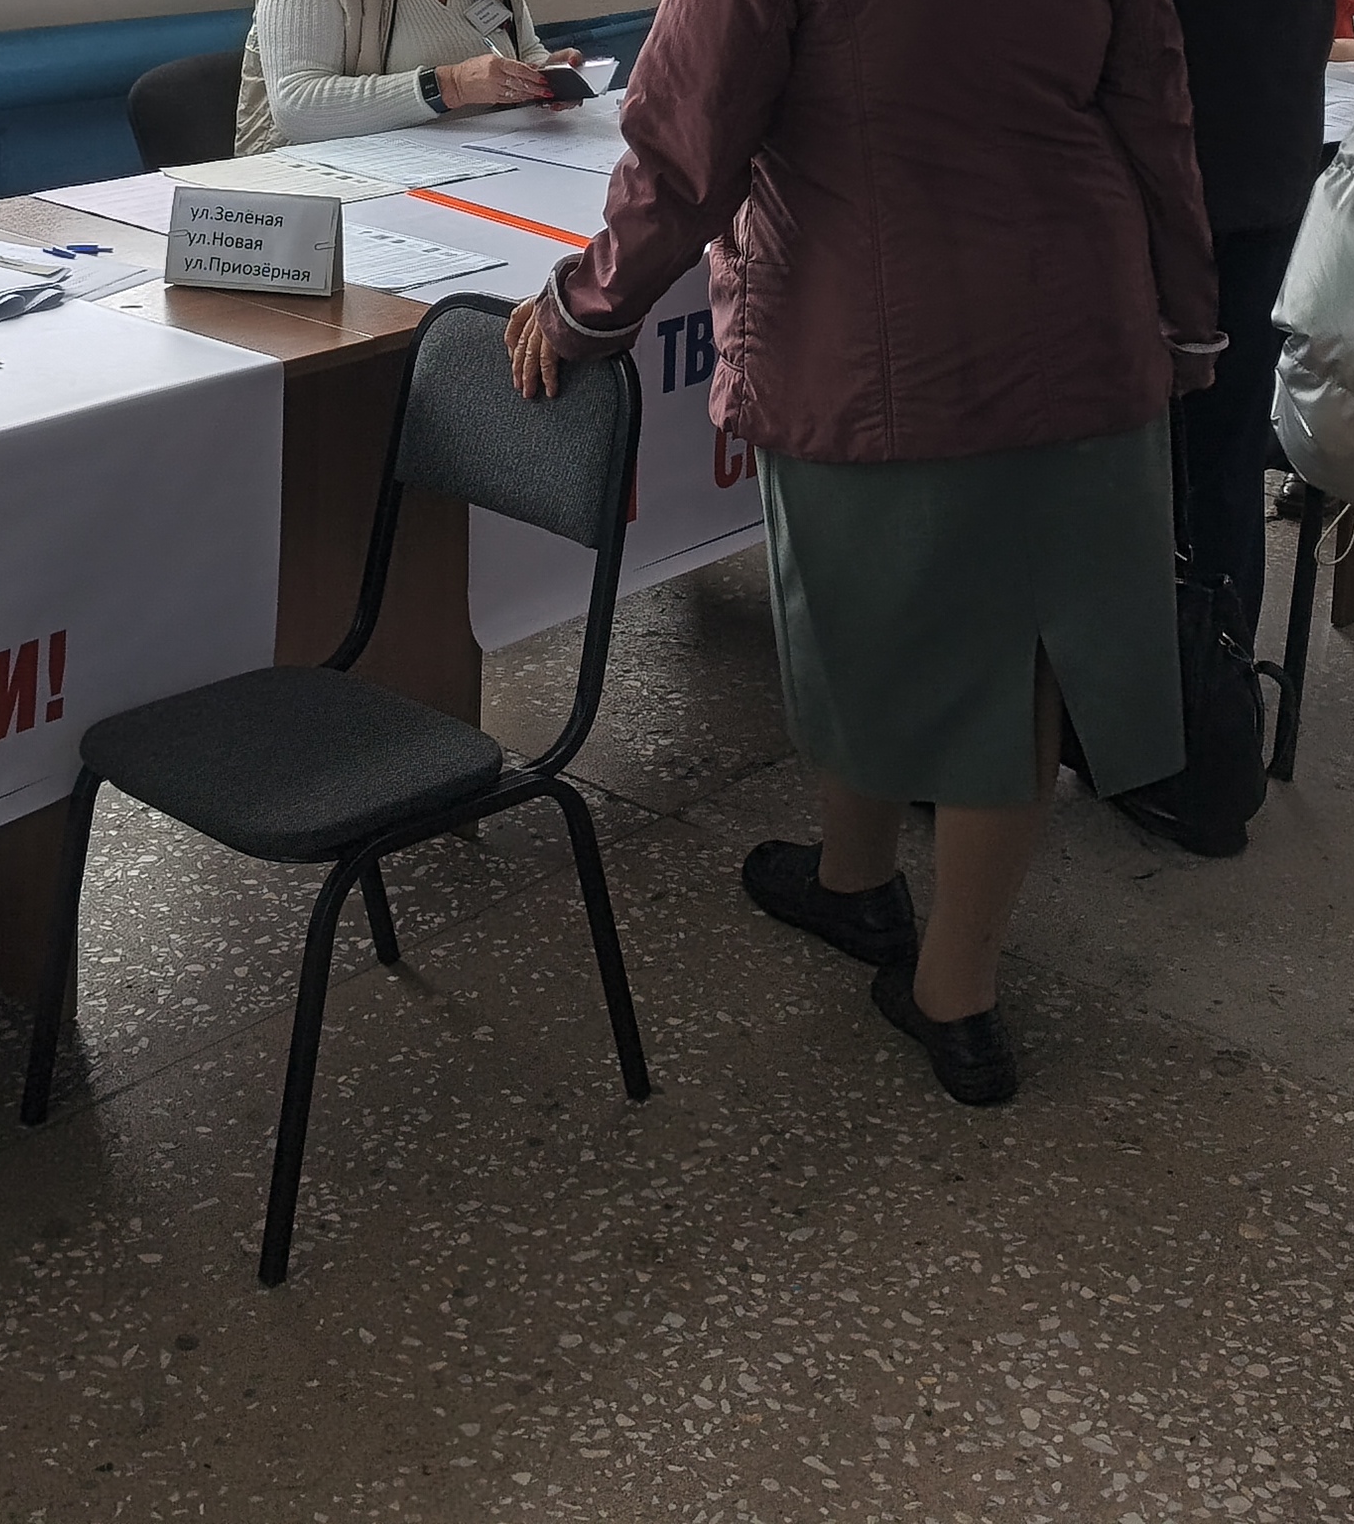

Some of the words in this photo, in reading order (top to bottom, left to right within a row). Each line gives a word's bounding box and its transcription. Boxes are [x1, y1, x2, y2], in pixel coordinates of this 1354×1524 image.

[190, 206, 284, 228] ул.Зелёная
[187, 231, 263, 251] ул.Новая
[184, 256, 311, 283] ул.Приозёрная
[658, 310, 716, 394] ТВ
